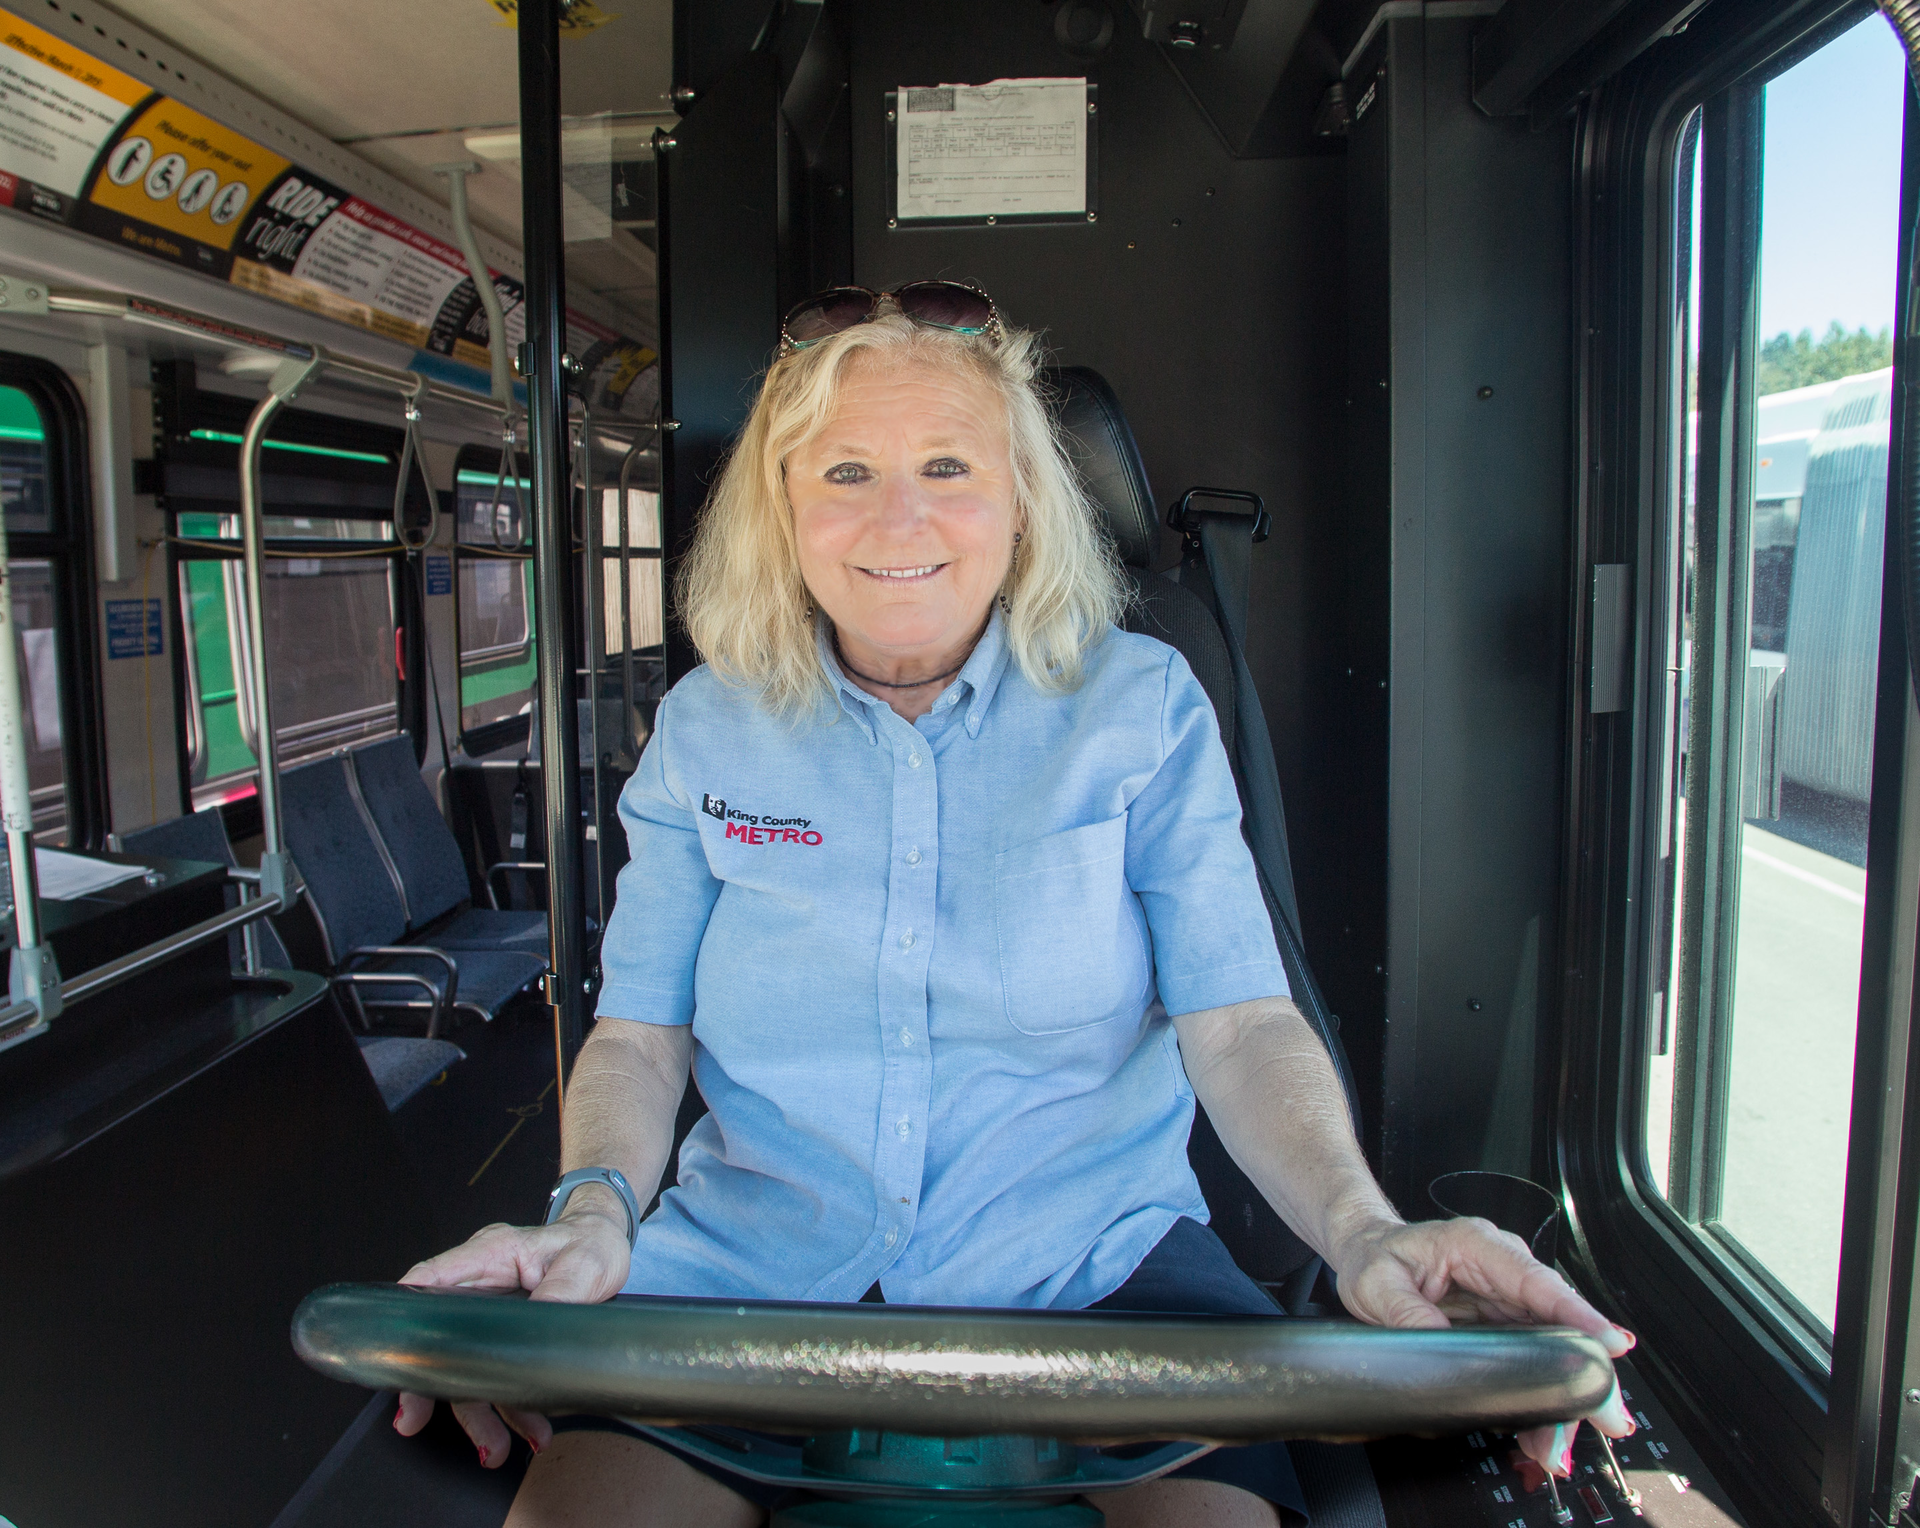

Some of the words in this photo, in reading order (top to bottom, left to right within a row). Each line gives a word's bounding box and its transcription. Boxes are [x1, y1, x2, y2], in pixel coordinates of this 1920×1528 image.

[266, 175, 341, 228] RIDE
[727, 808, 759, 825] King
[762, 815, 812, 829] County
[725, 822, 823, 847] METRO
[1646, 1440, 1664, 1460] REQUEST
[1656, 1441, 1670, 1454] STOP
[1479, 1461, 1491, 1475] LIGHT
[1584, 1465, 1595, 1475] OFF
[1492, 1489, 1505, 1504] LIGHT
[1500, 1485, 1515, 1504] STROBE
